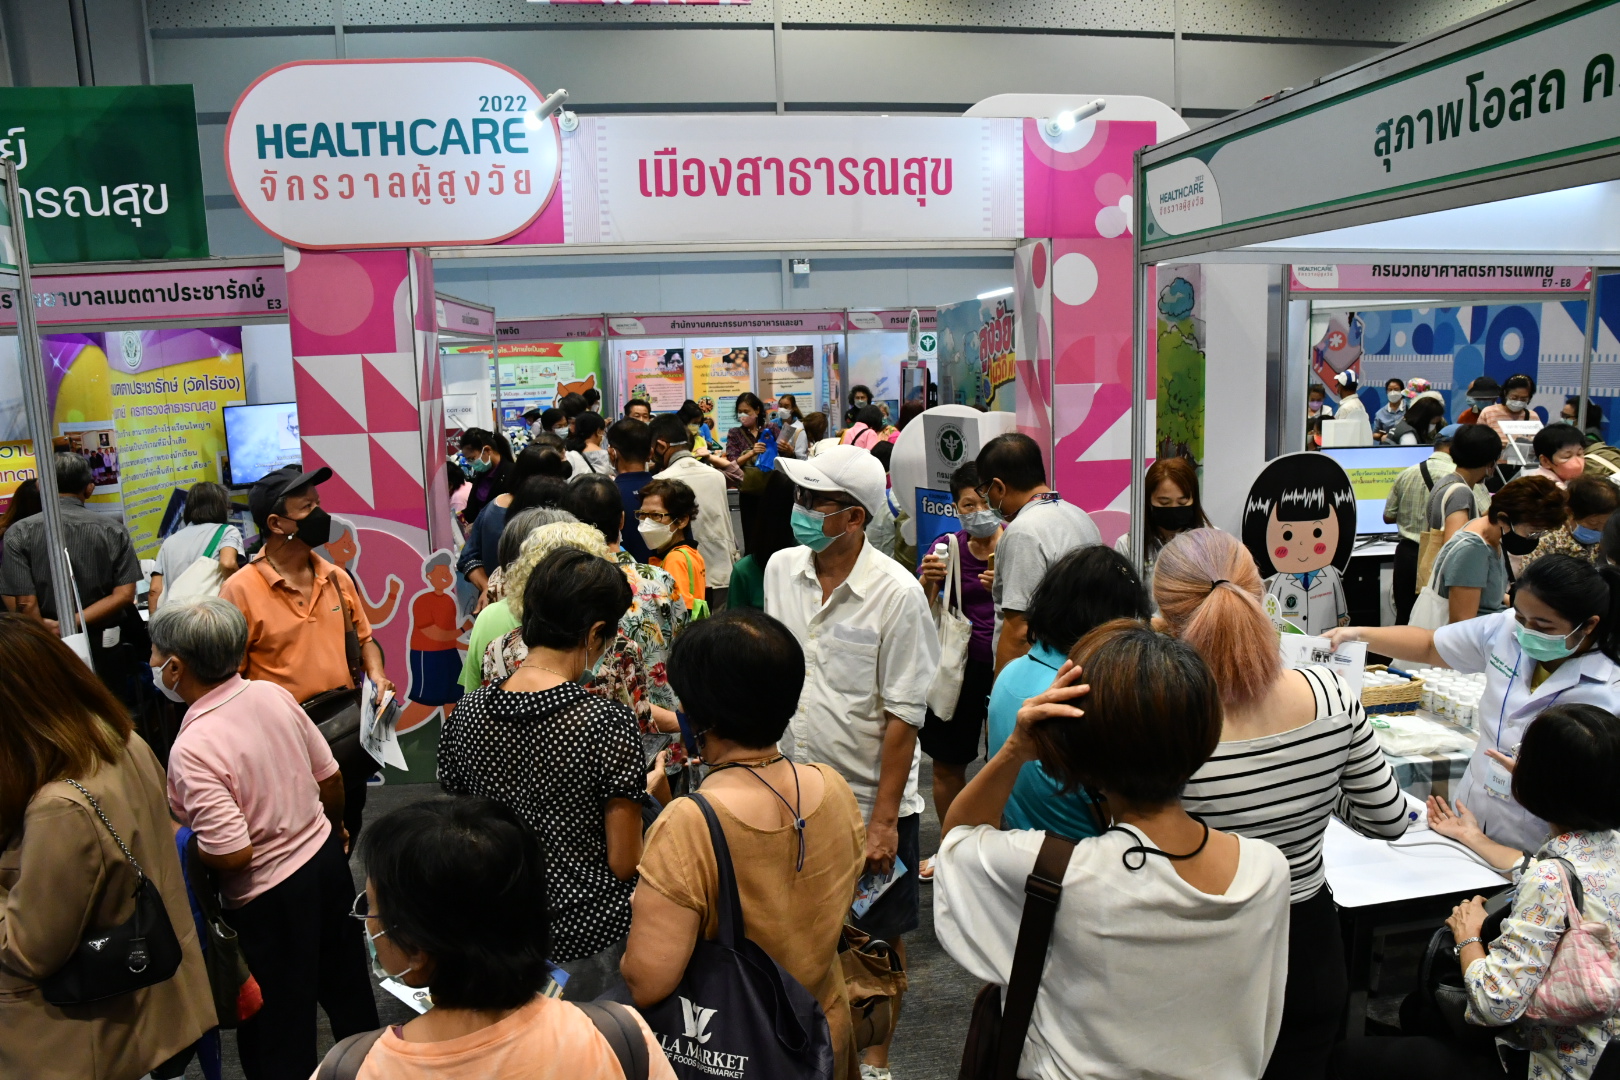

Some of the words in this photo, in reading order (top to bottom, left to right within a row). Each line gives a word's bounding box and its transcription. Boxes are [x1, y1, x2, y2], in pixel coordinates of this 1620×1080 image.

[478, 95, 527, 112] 2022
[1373, 68, 1566, 173] สุภาพโอสถ
[1582, 53, 1620, 103] ค
[256, 117, 530, 160] HEALTHCARE
[260, 163, 532, 205] จักรวาลผู้สูงวัย
[637, 146, 953, 208] เมืองสาธารณสุข
[1159, 181, 1205, 205] HEALTHCARE
[1542, 278, 1553, 288] E7
[1560, 278, 1571, 288] E8
[267, 299, 282, 309] E3
[670, 319, 804, 330] สำนักงานคณะกรรมการอาหารและยา
[183, 374, 240, 394] (วัดไร่ขิง)
[130, 401, 216, 418] กระทรวงสาธารณสุข
[673, 1053, 697, 1068] FOODS
[685, 1041, 749, 1072] MARKET
